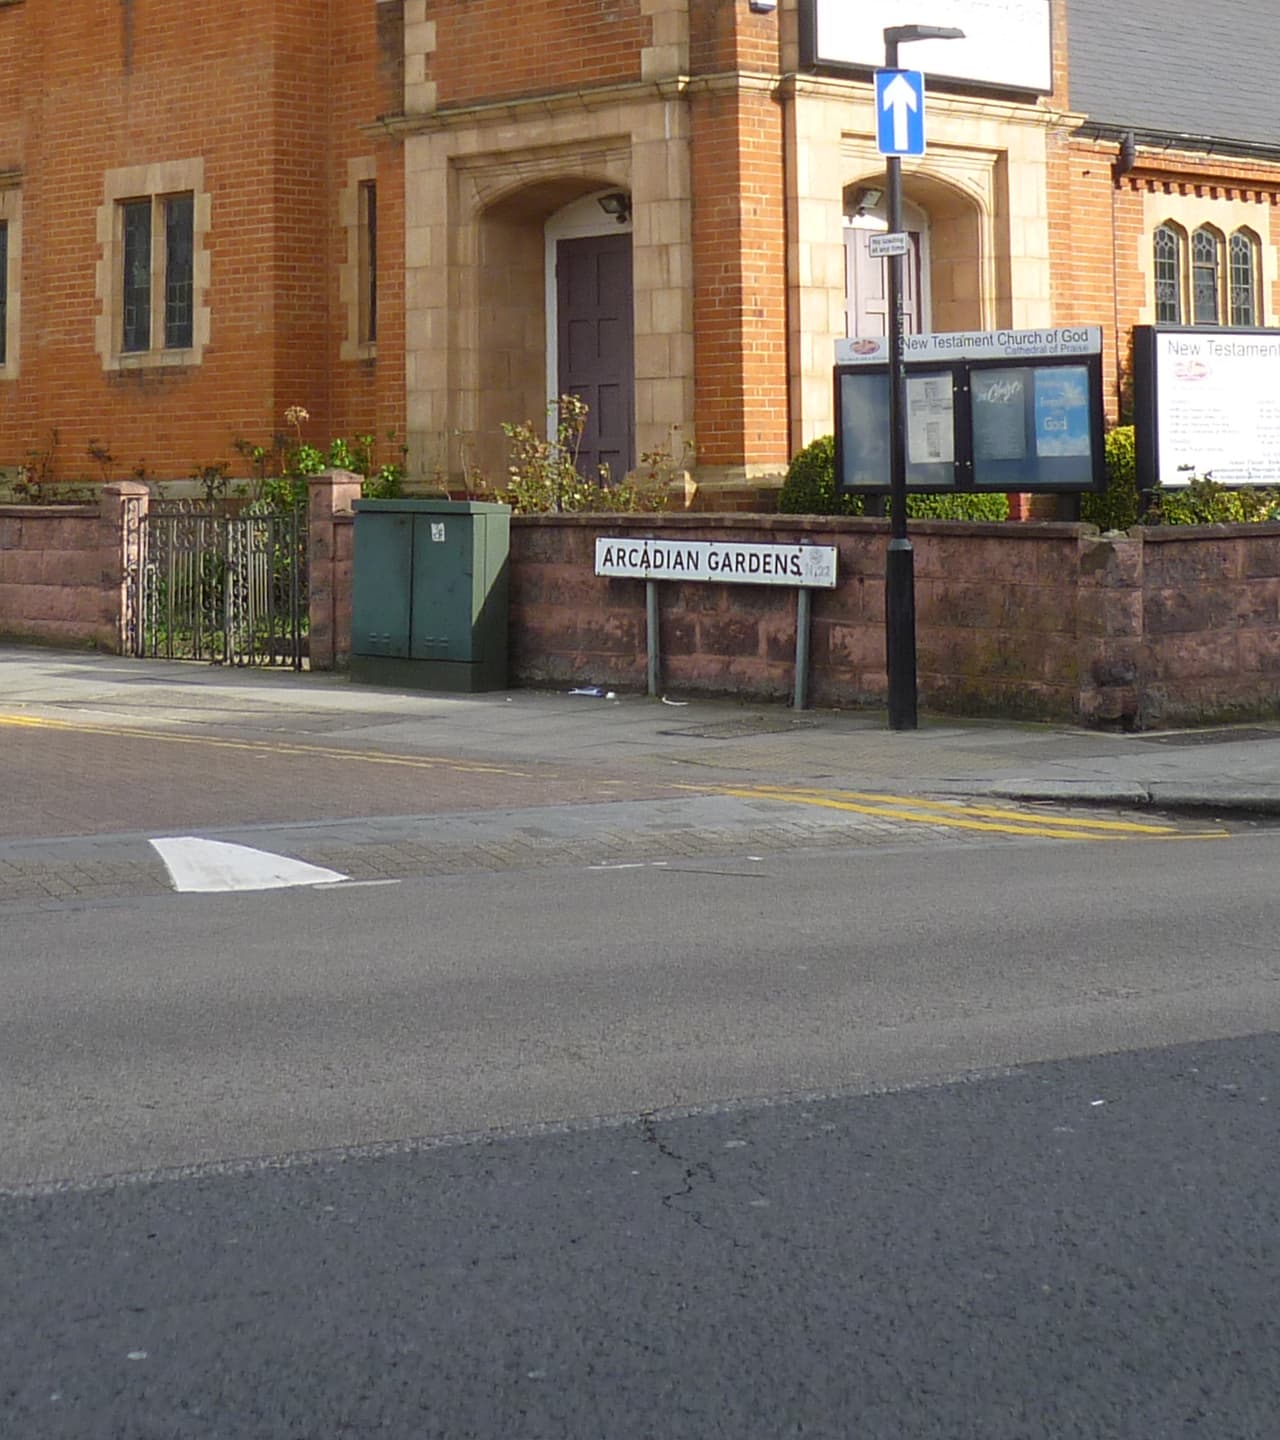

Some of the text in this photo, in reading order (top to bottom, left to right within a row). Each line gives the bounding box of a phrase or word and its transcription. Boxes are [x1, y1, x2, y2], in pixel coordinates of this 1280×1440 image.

[904, 328, 1088, 350] New Testament Church of God
[1004, 342, 1089, 356] Cathedral of Praise
[1168, 339, 1201, 357] New
[603, 547, 699, 571] ARCADIAN
[708, 551, 801, 576] GARDENS
